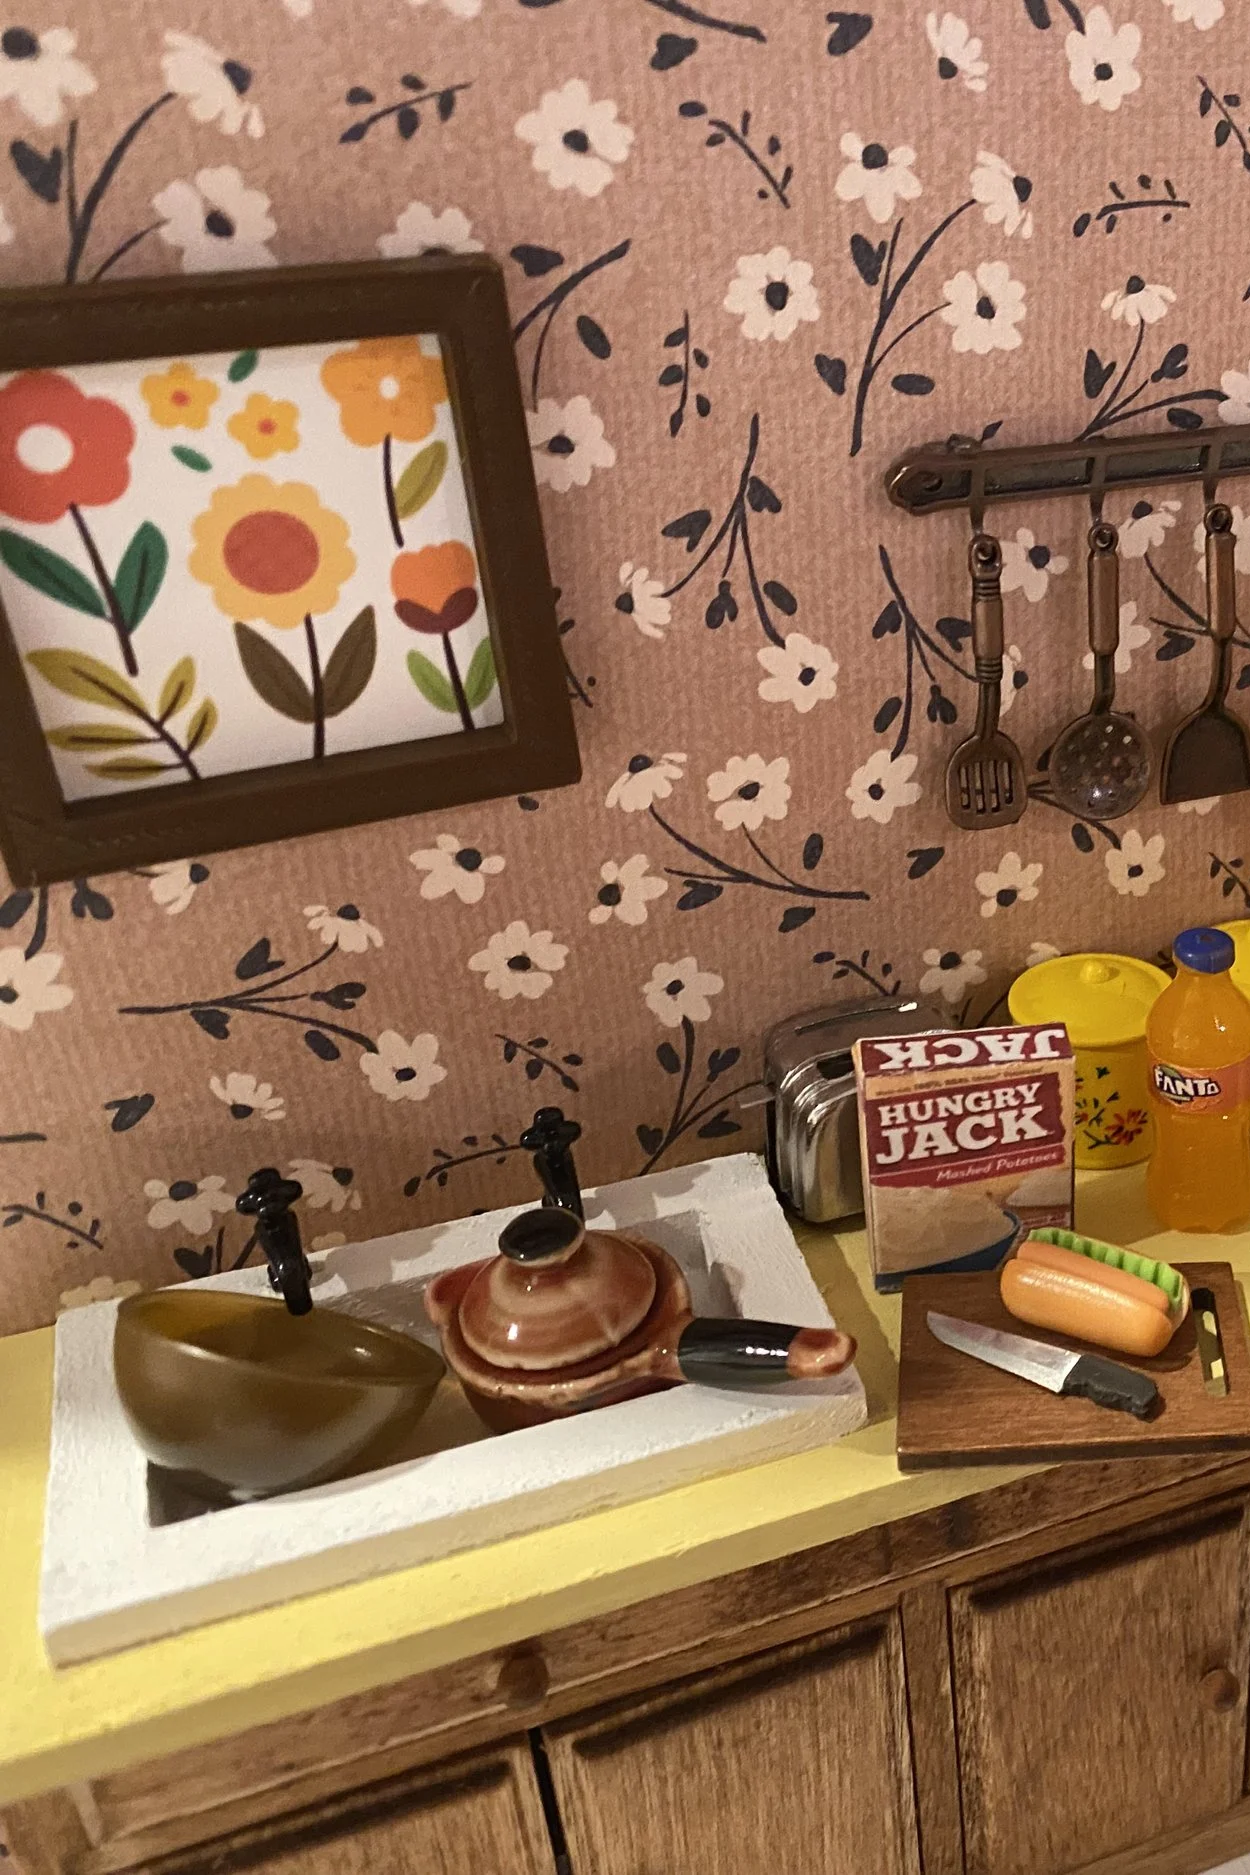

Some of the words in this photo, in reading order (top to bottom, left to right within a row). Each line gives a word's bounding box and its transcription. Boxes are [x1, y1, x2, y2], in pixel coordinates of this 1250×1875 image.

[873, 1029, 1066, 1070] JACK
[877, 1082, 1042, 1127] HUNGRY
[875, 1104, 1048, 1166] JACK
[936, 1162, 991, 1182] Mashed
[995, 1152, 1058, 1172] Potatoes
